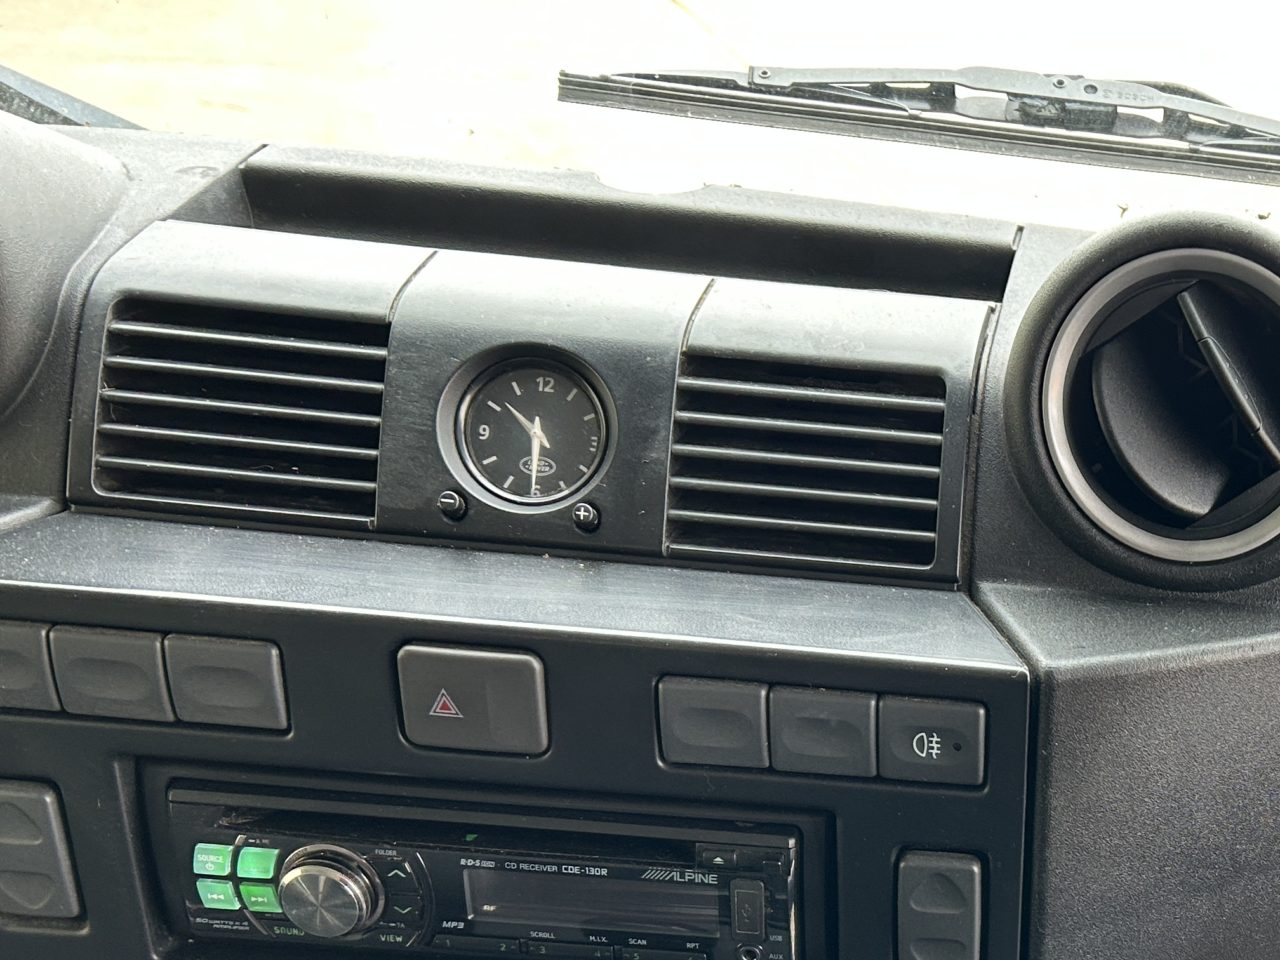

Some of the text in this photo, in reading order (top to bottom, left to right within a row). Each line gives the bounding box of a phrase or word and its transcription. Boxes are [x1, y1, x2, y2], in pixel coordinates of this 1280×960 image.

[536, 377, 554, 393] 12
[478, 424, 490, 440] 9
[197, 854, 224, 863] SOURCE
[504, 861, 517, 870] CD
[520, 862, 558, 872] RECEIVER
[562, 865, 608, 876] CDE-130R
[660, 870, 719, 885] ALPINE
[442, 920, 465, 929] MP3
[274, 925, 305, 936] SOUND
[530, 931, 556, 939] SCROLL
[380, 934, 403, 943] VIEW
[539, 946, 546, 954] 3
